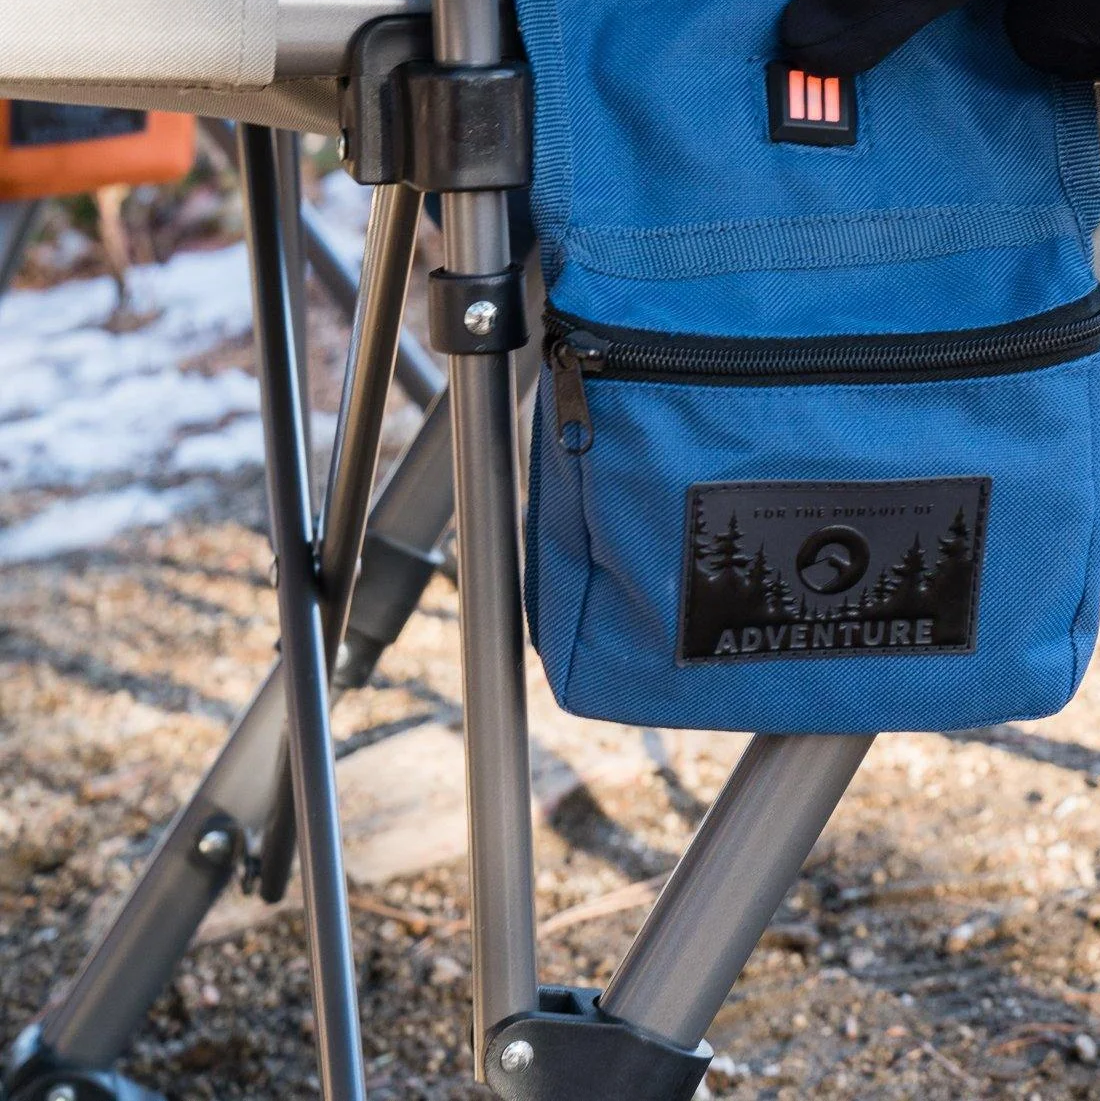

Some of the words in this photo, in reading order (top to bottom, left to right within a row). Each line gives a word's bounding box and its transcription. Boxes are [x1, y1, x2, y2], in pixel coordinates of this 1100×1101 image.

[753, 506, 786, 519] FOR
[795, 506, 826, 519] THE
[832, 505, 906, 518] PURSUIT
[914, 503, 936, 516] OF
[714, 618, 934, 655] ADVENTURE
